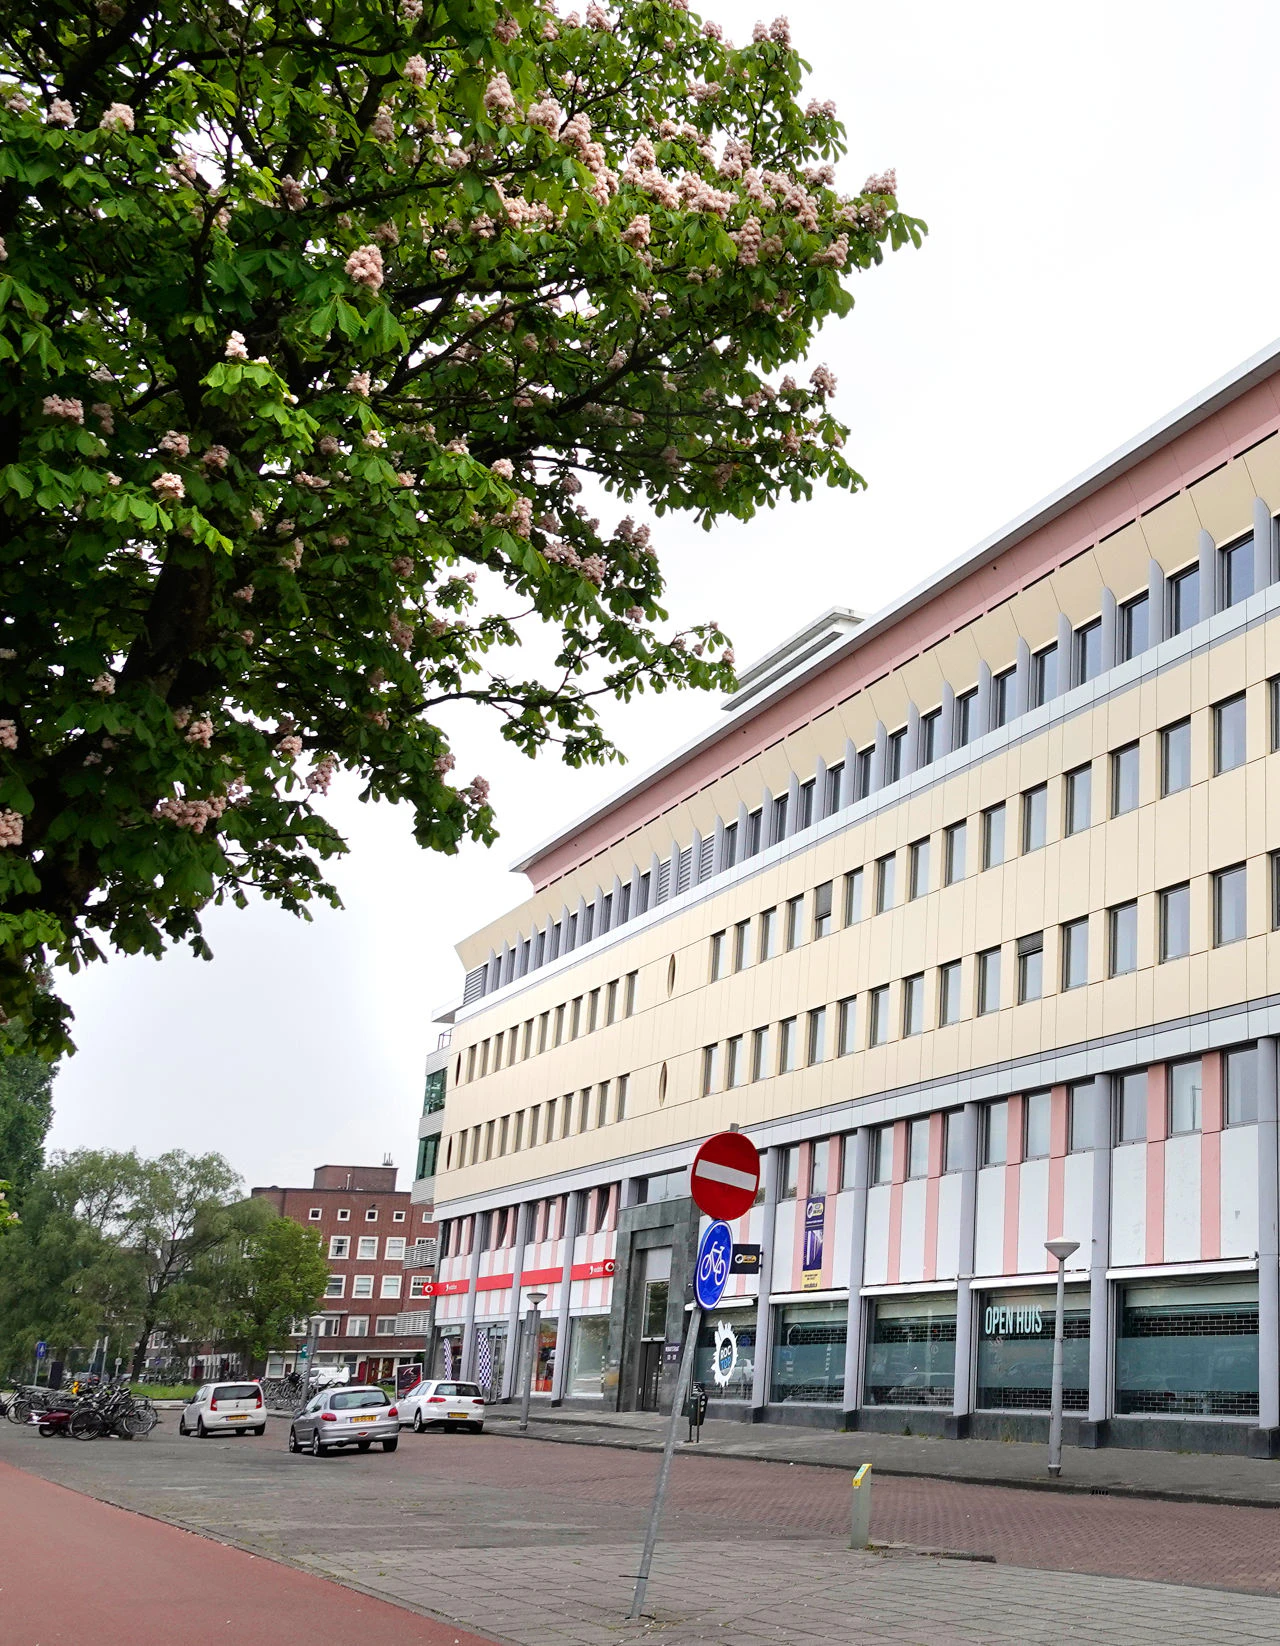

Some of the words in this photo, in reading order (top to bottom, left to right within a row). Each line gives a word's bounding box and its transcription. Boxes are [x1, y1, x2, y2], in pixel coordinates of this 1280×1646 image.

[985, 1305, 1014, 1335] OPEN
[1016, 1303, 1043, 1333] HUIS
[720, 1345, 732, 1360] ROC
